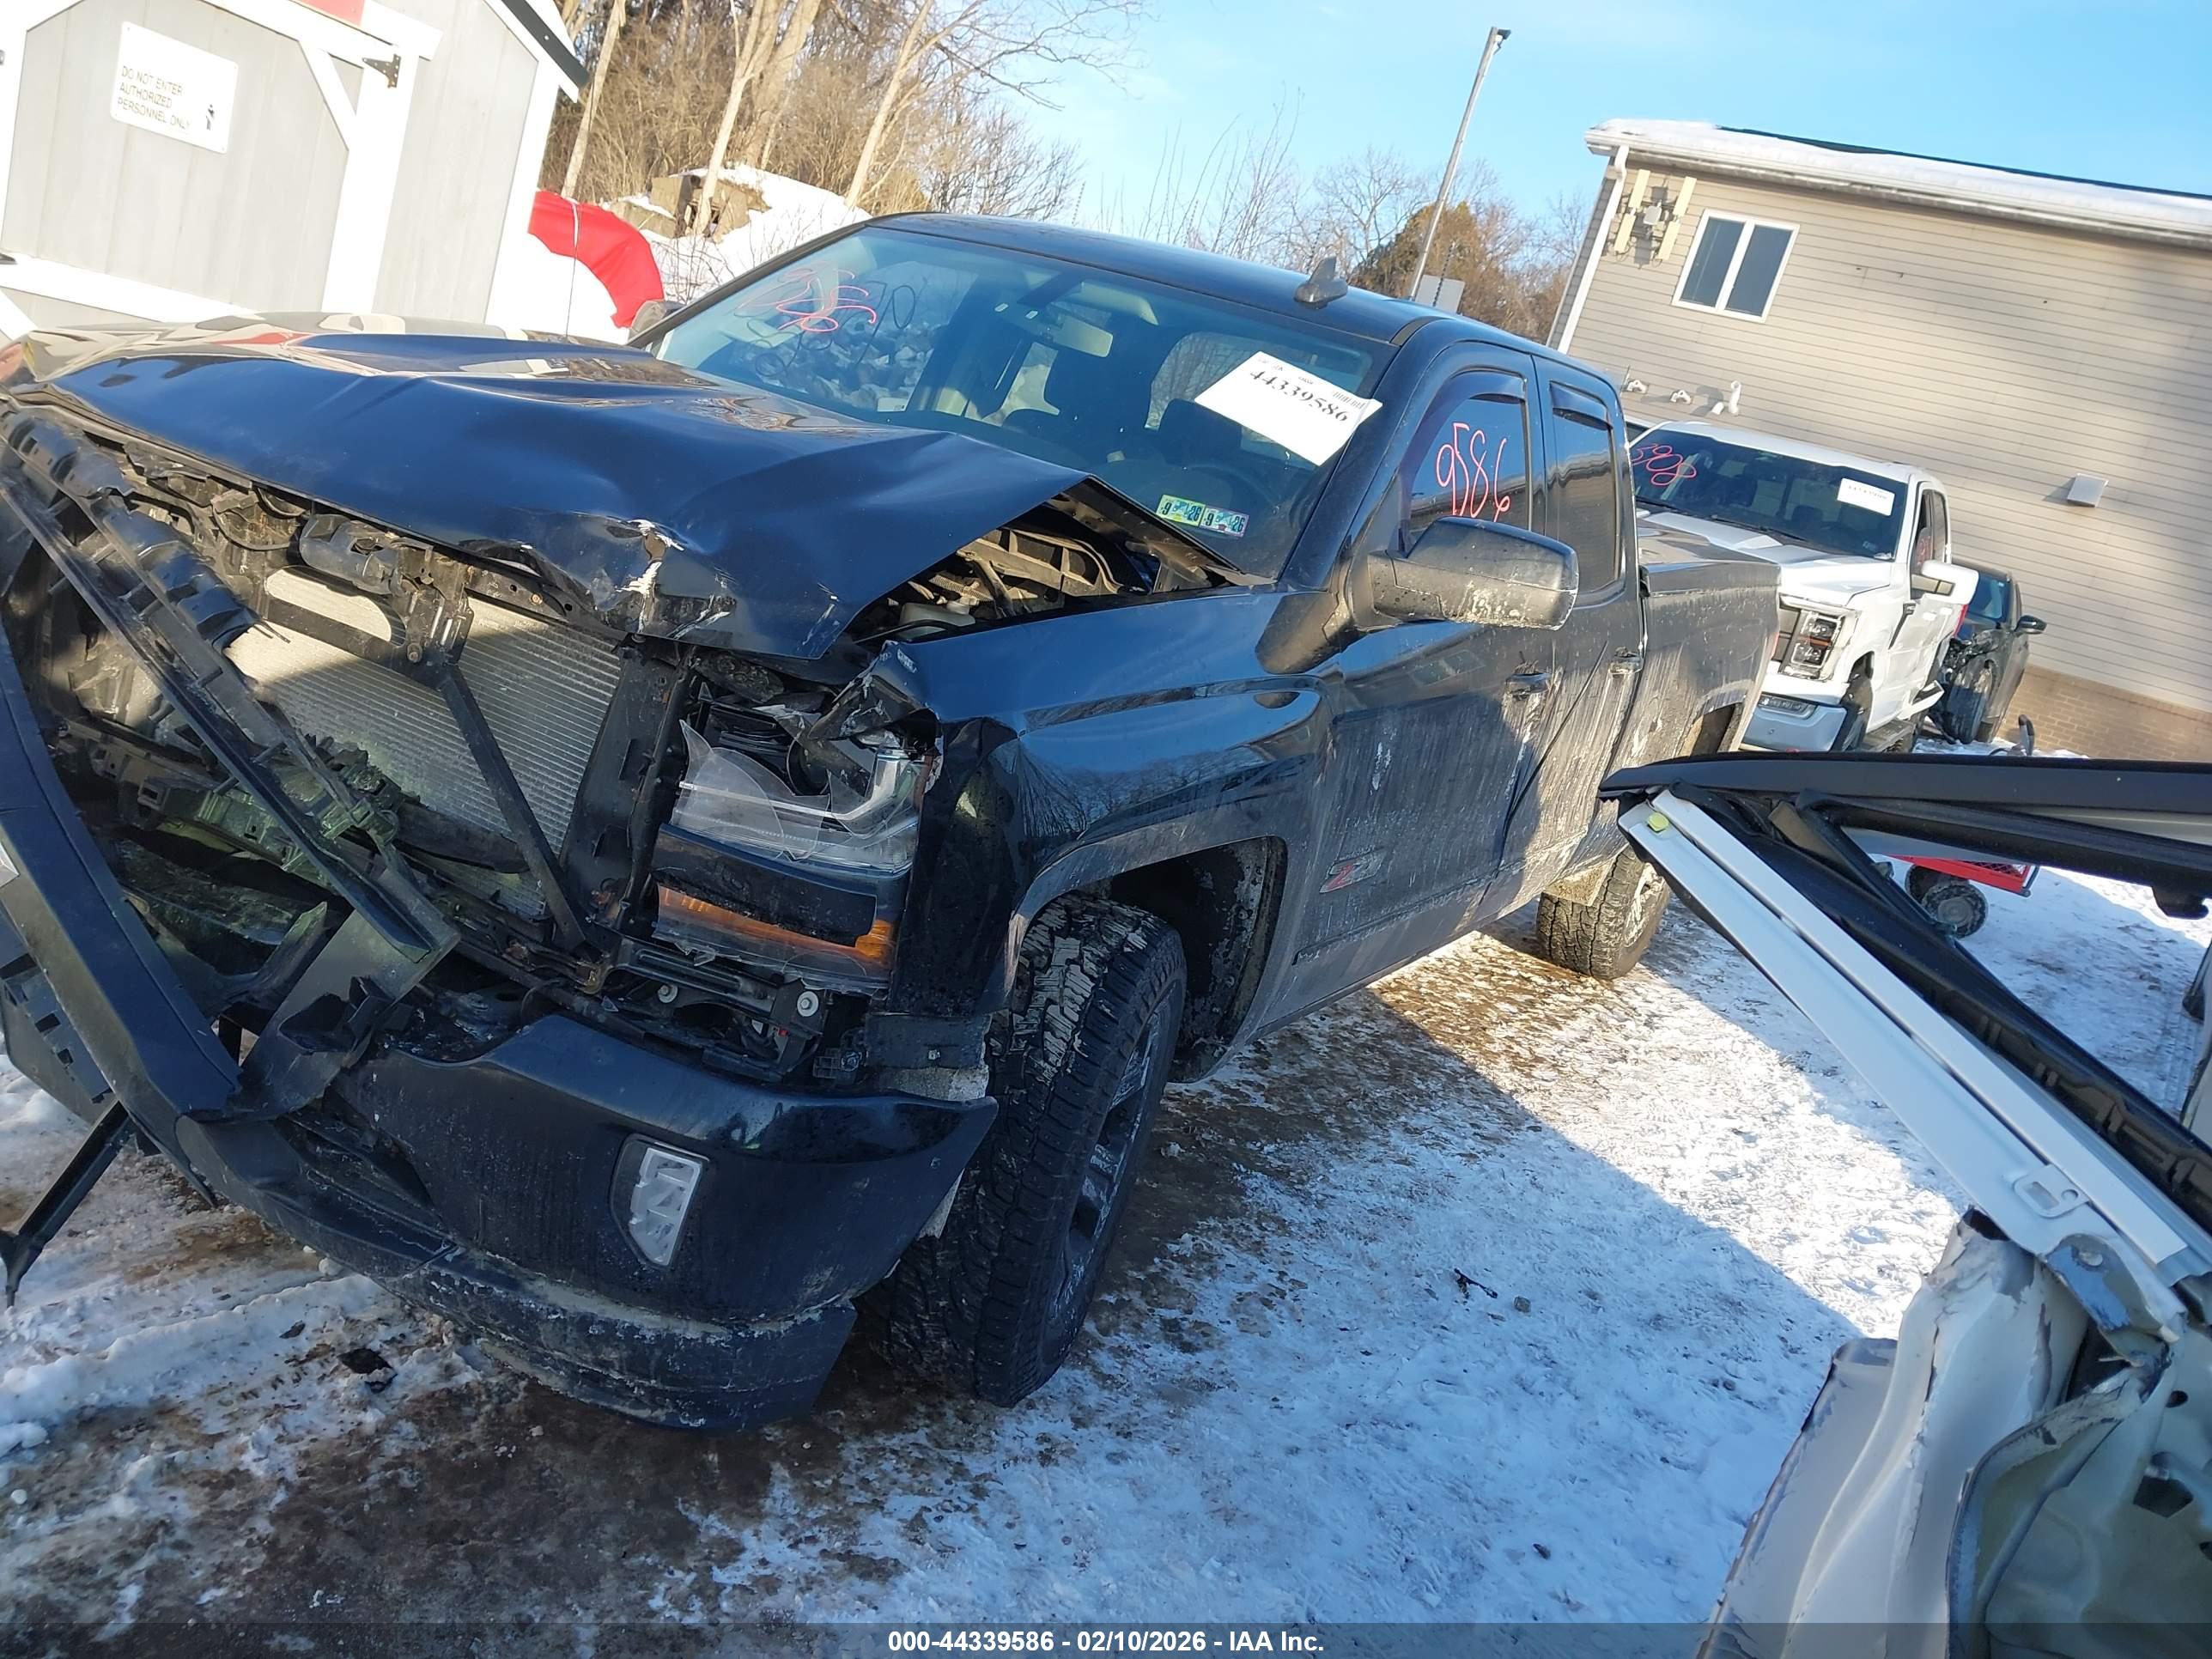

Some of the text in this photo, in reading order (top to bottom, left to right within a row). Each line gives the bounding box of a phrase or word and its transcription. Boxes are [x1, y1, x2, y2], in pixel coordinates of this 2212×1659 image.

[119, 82, 173, 108] AUTHORIZED
[122, 66, 184, 95] DO NOT ENTER
[118, 97, 193, 130] PERSONNEL ONLY
[1249, 370, 1348, 422] 44339586
[1436, 422, 1511, 523] 9586
[1162, 501, 1173, 515] 9
[1206, 513, 1245, 532] 9 26
